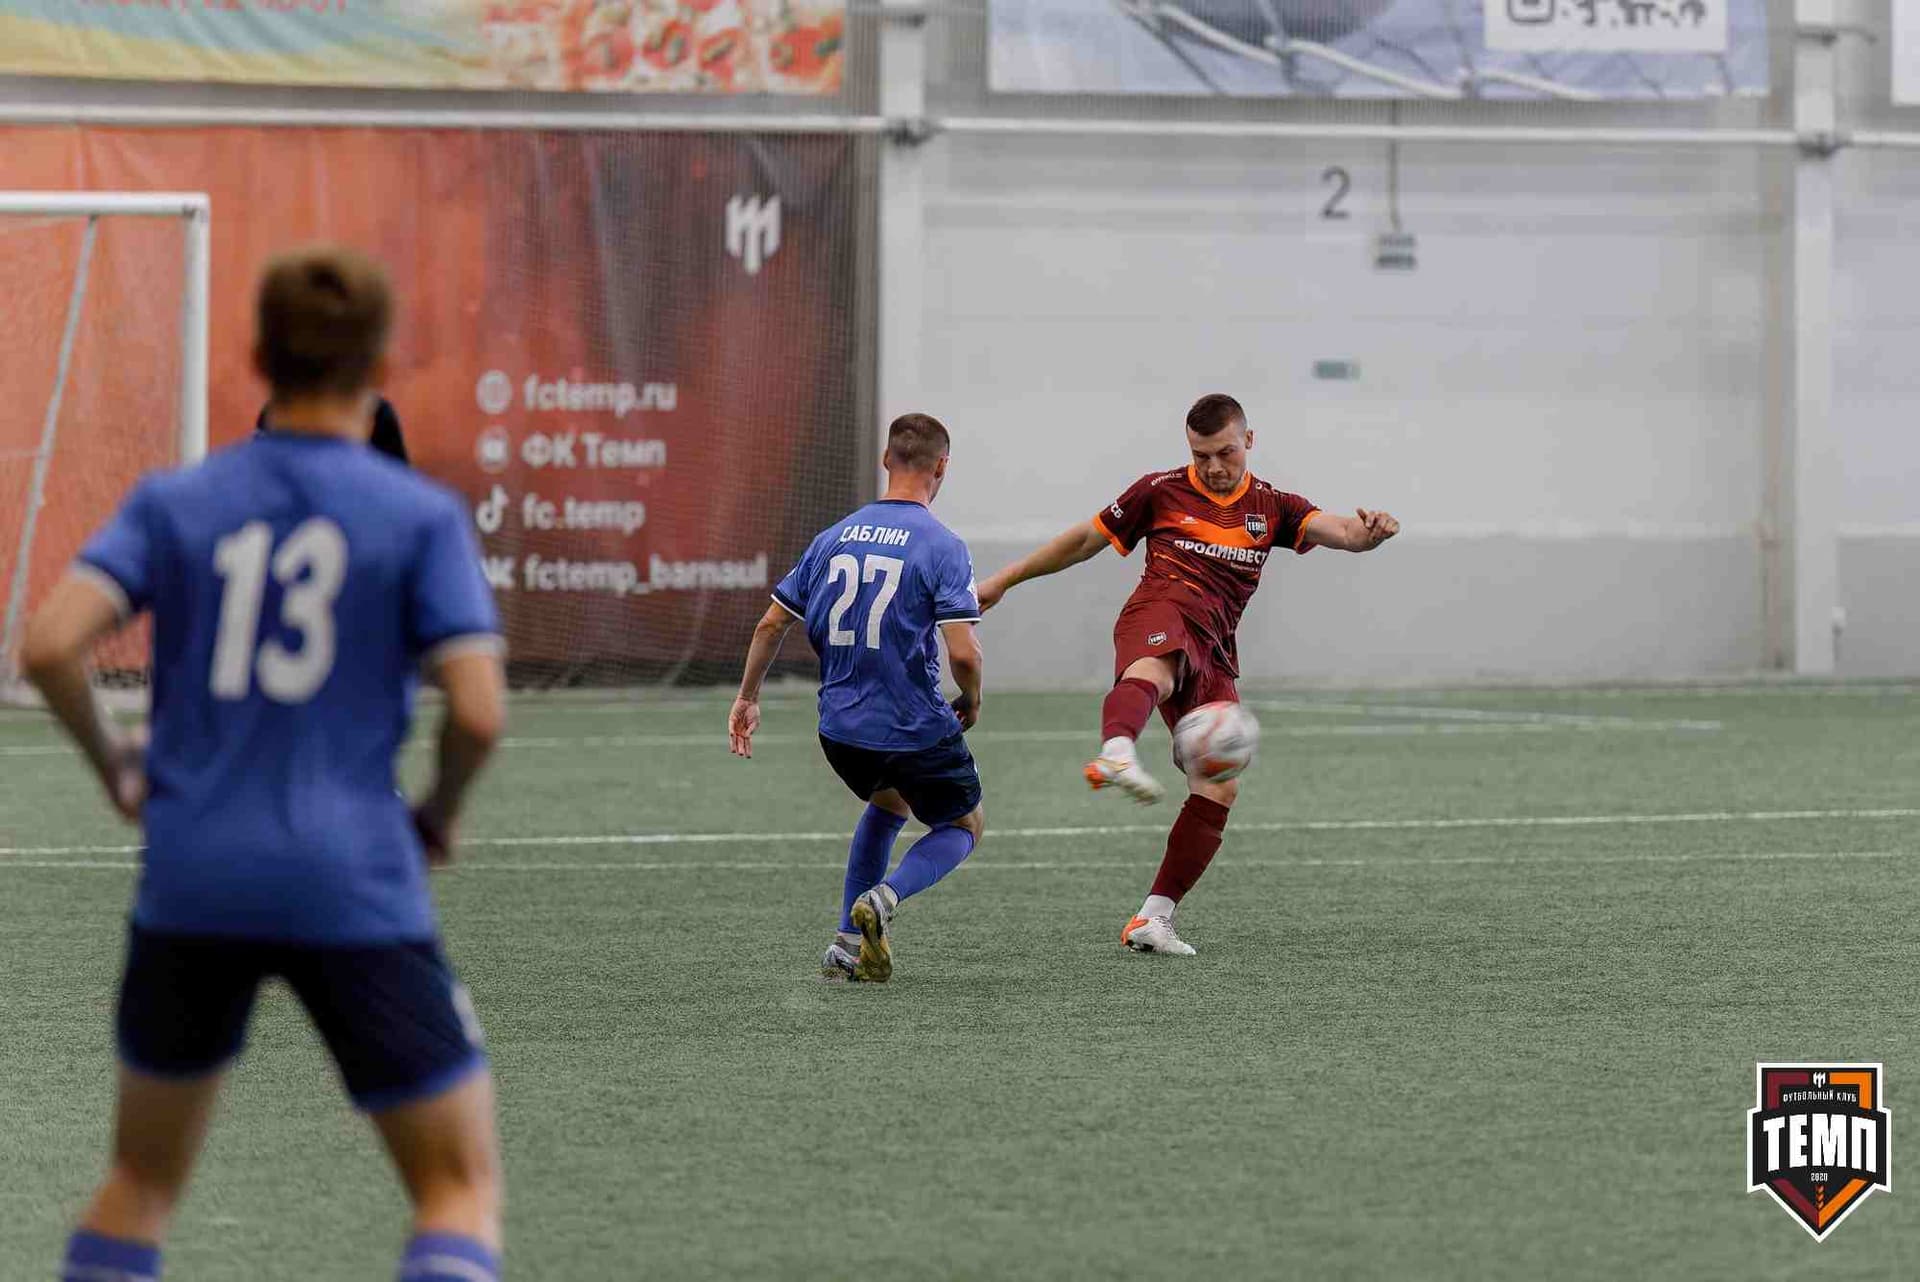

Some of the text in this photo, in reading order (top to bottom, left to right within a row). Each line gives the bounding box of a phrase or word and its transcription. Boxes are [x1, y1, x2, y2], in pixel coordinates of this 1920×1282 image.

[1320, 166, 1351, 219] 2
[523, 374, 678, 417] fctemp.ru
[521, 431, 667, 468] ФК Темп
[522, 493, 646, 536] fc.temp
[840, 525, 911, 546] САБЛИН
[524, 553, 768, 596] fctemp_barnaul
[209, 515, 348, 705] 13
[827, 553, 905, 650] 27
